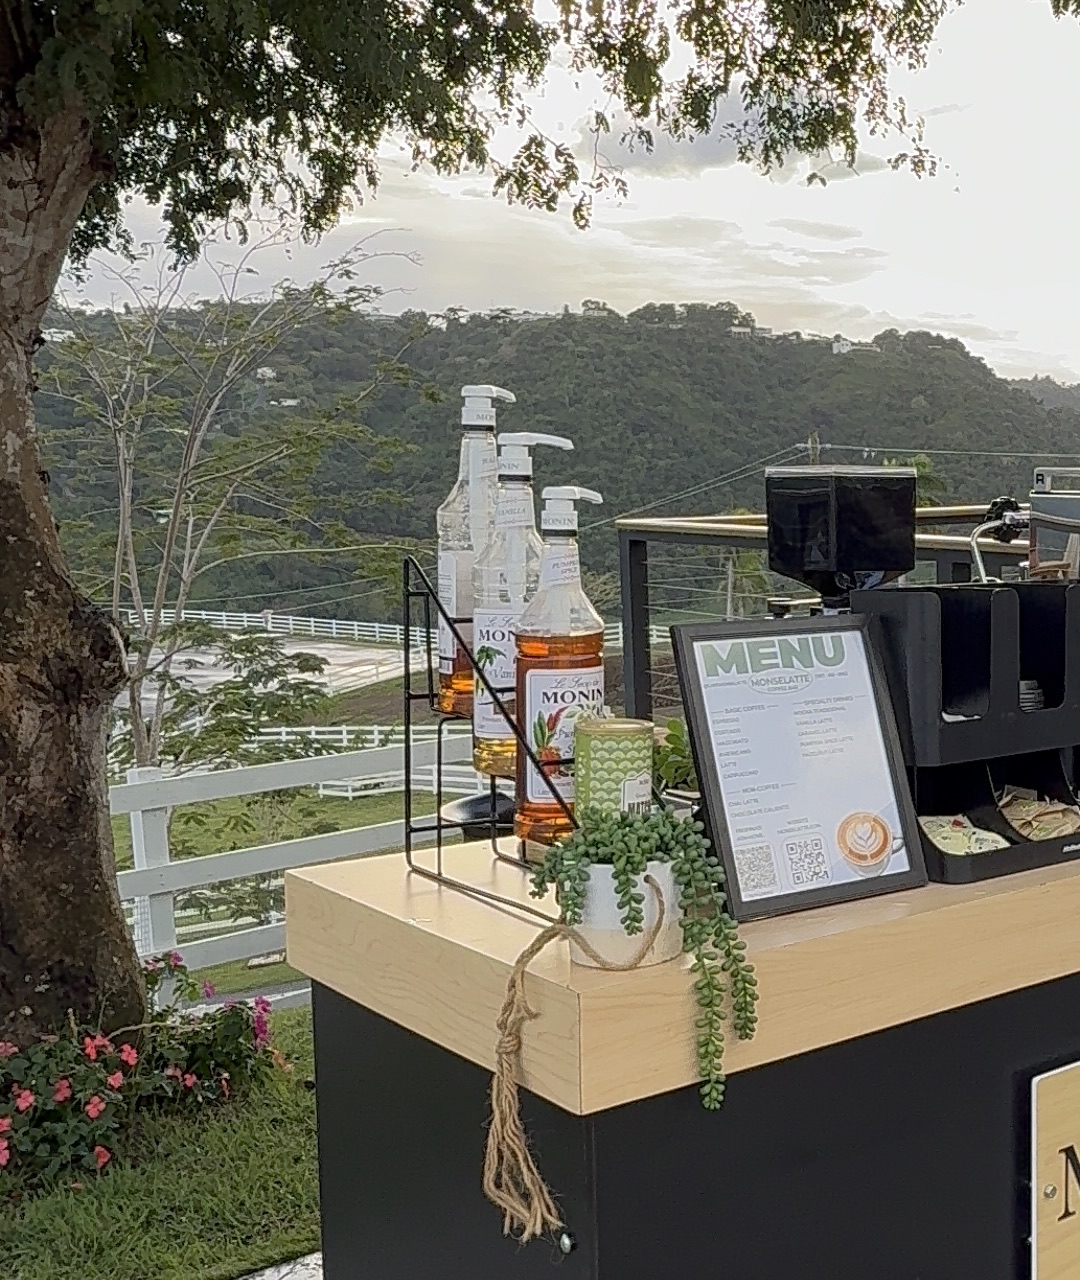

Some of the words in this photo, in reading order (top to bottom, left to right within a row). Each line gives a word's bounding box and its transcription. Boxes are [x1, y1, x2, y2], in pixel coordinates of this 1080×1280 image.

[1036, 474, 1044, 484] R
[479, 629, 515, 642] MON
[702, 635, 845, 677] MENU
[751, 674, 810, 687] MONSELATTE
